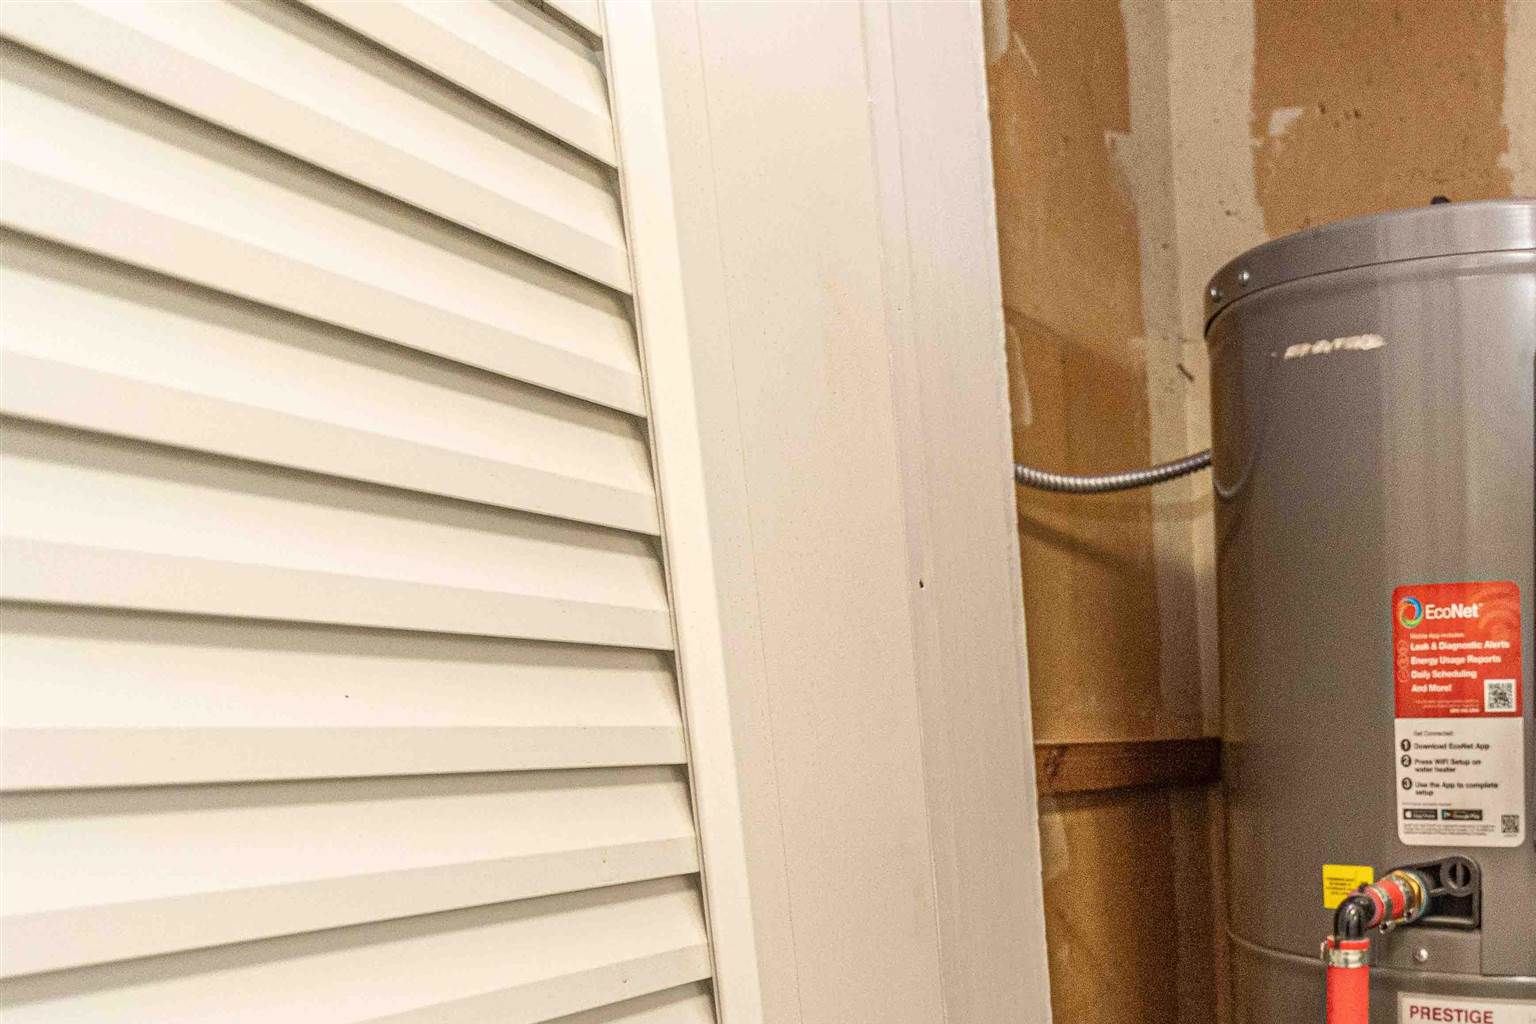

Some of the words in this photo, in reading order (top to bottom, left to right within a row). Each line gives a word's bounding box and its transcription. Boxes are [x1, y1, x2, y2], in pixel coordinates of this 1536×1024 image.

[1425, 604, 1479, 619] EcoNet
[1410, 642, 1430, 651] Leak
[1439, 641, 1482, 651] Diagnostic
[1483, 640, 1510, 649] Alerts
[1410, 656, 1438, 666] Energy
[1440, 656, 1465, 665] Usage
[1466, 654, 1501, 665] Reports
[1411, 670, 1431, 680] Daily
[1431, 669, 1477, 680] Scheduling
[1414, 743, 1447, 751] Download
[1449, 743, 1473, 751] EcoNet
[1475, 743, 1490, 752] App
[1415, 758, 1433, 766] Press
[1450, 758, 1470, 767] Setup
[1442, 782, 1455, 790] App
[1466, 782, 1499, 791] complete
[1416, 789, 1434, 797] setup
[1409, 1005, 1494, 1024] PRESTIGE
